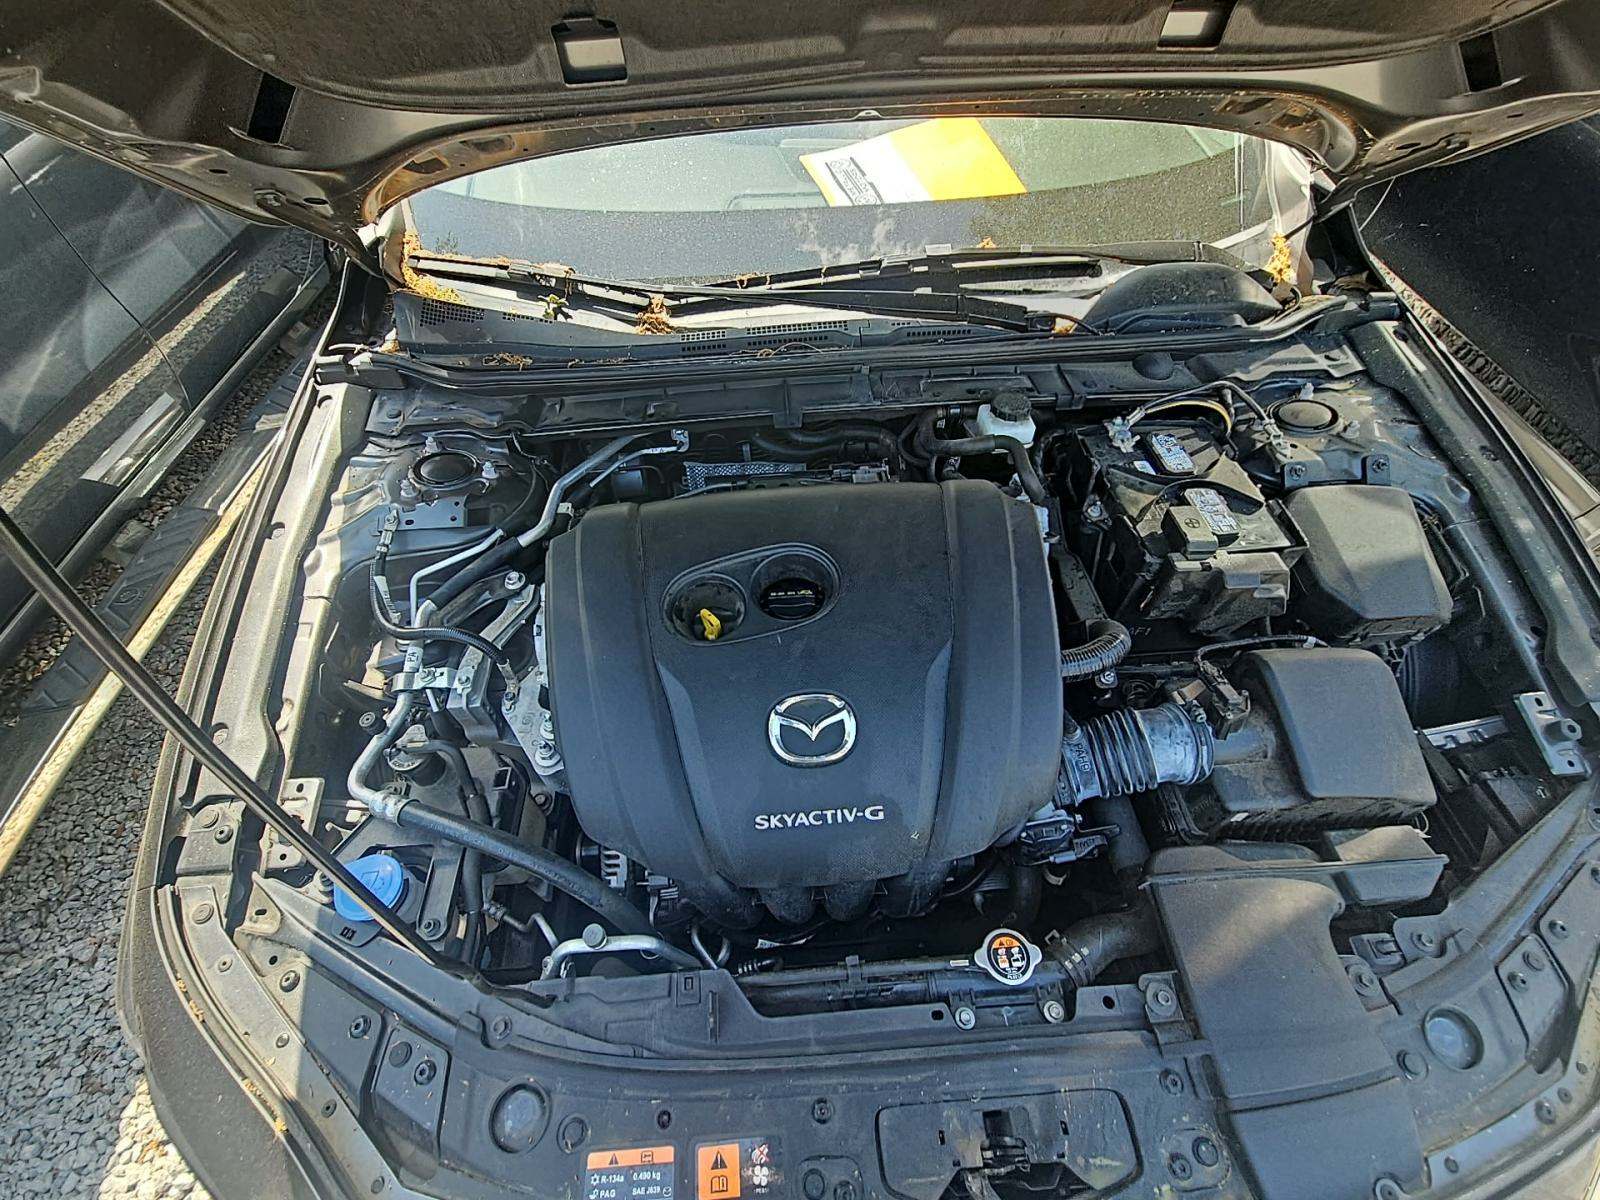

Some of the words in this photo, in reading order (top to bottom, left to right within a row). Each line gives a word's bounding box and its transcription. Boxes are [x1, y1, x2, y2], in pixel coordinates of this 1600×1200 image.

[754, 805, 885, 830] SKYACTIV-G
[600, 1174, 624, 1184] R-134a
[652, 1170, 661, 1181] kg
[600, 1189, 616, 1199] PAG
[632, 1187, 645, 1196] SAE
